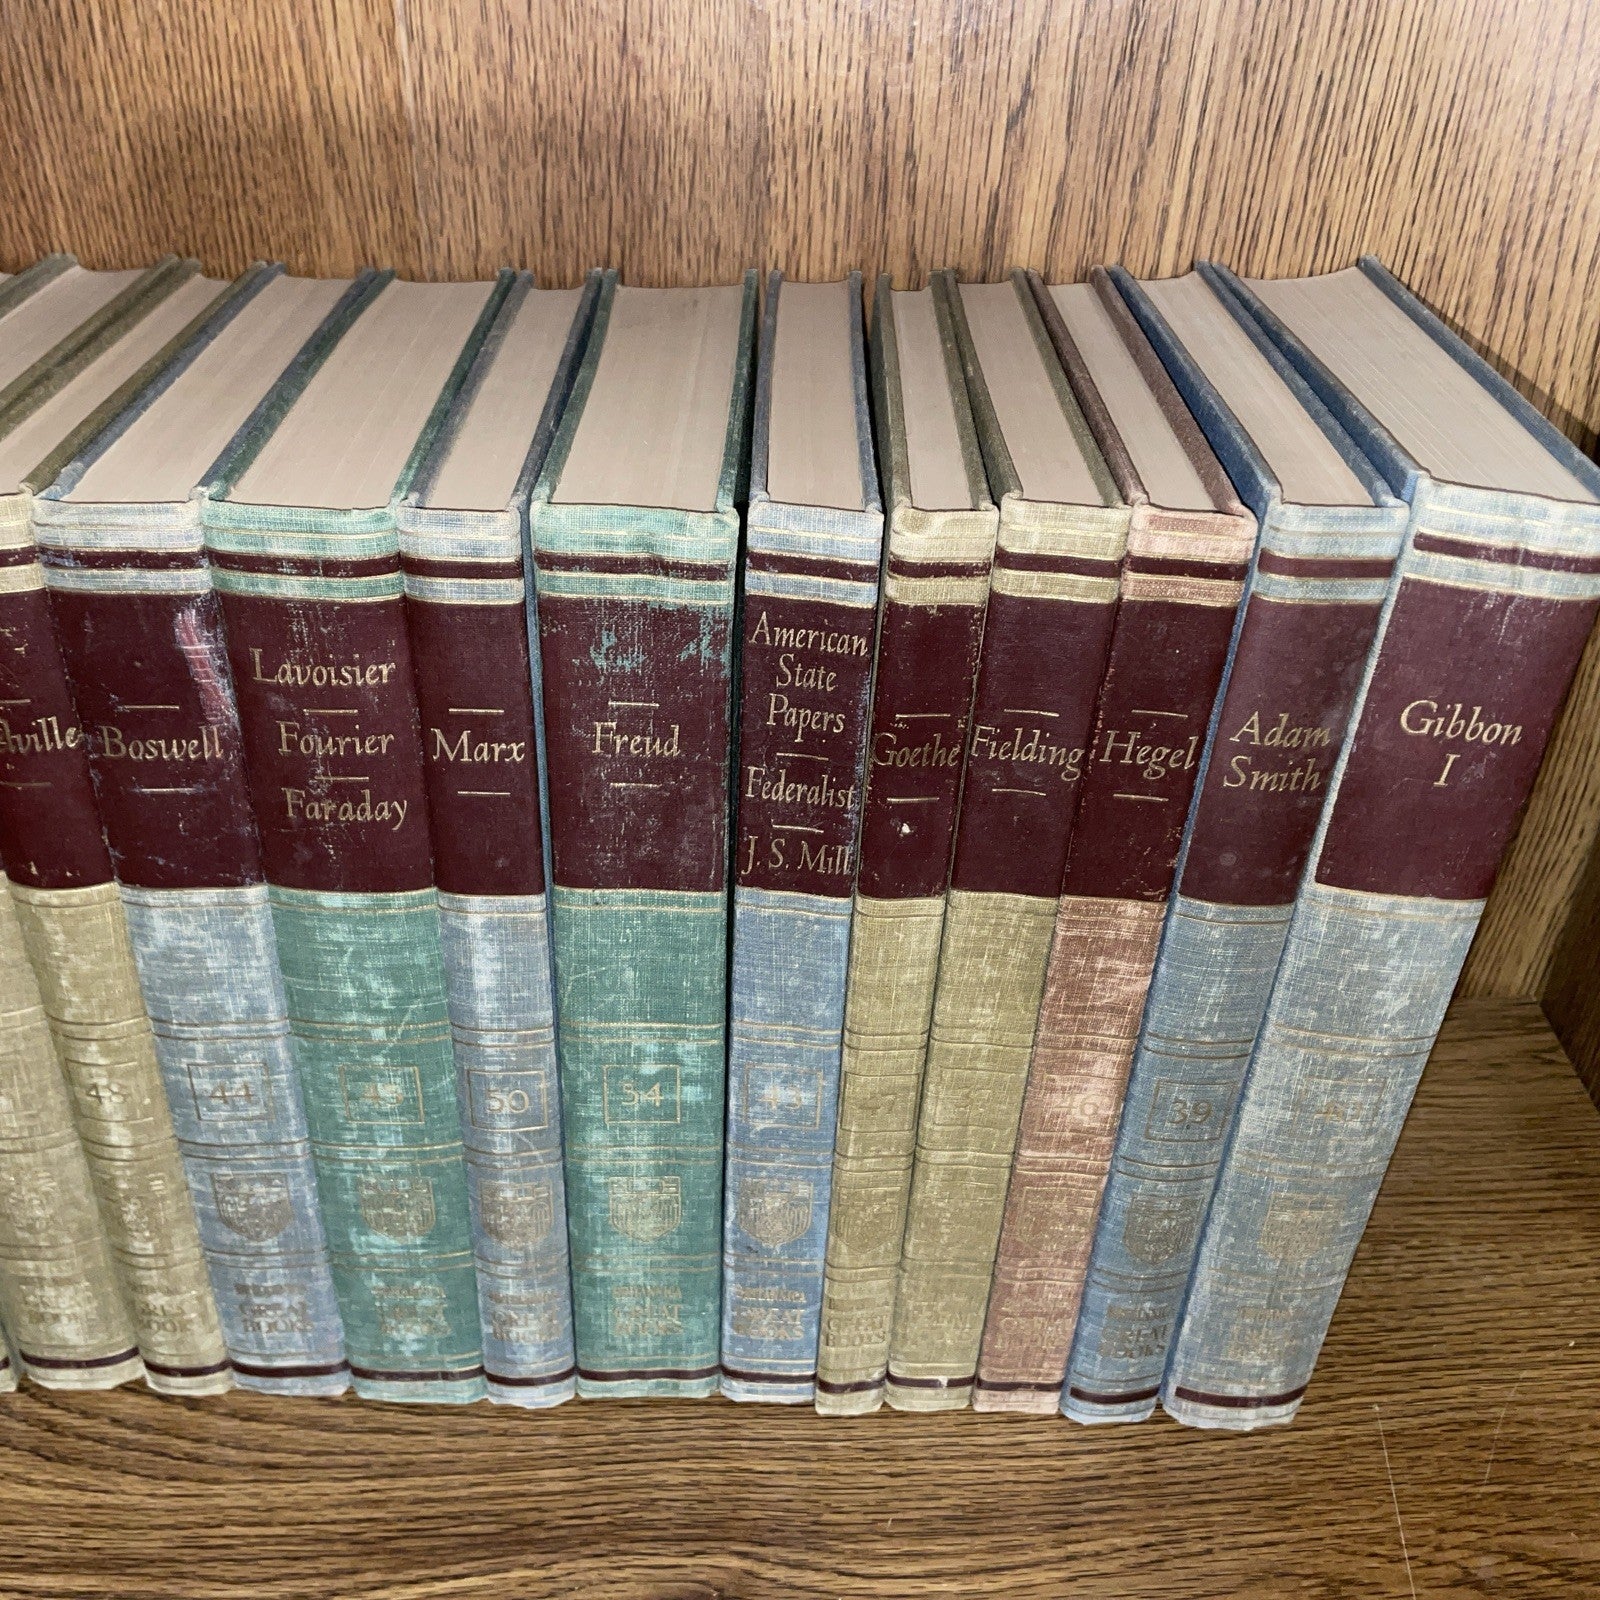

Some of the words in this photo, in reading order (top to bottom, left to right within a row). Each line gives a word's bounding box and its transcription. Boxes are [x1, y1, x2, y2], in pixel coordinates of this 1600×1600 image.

[750, 611, 868, 657] American
[249, 646, 397, 686] Lavoisier
[776, 653, 837, 692] State
[766, 693, 846, 743] Papers
[1229, 710, 1332, 748] Adam
[1400, 700, 1523, 746] Gibbon
[98, 724, 225, 761] Boswell
[276, 719, 395, 758] Fourier
[430, 728, 526, 763] Marx
[592, 721, 682, 758] Freud
[871, 731, 960, 768] Goethe
[970, 725, 1086, 781] Fielding
[1099, 730, 1200, 780] Hegel
[745, 766, 855, 810] Federalist
[1223, 754, 1322, 792] Smith
[1432, 753, 1461, 788] I
[281, 786, 408, 830] Faraday
[741, 835, 761, 875] J.
[769, 839, 790, 869] S.
[799, 840, 851, 876] Mill
[485, 1086, 532, 1115] 50
[1169, 1099, 1214, 1125] 39
